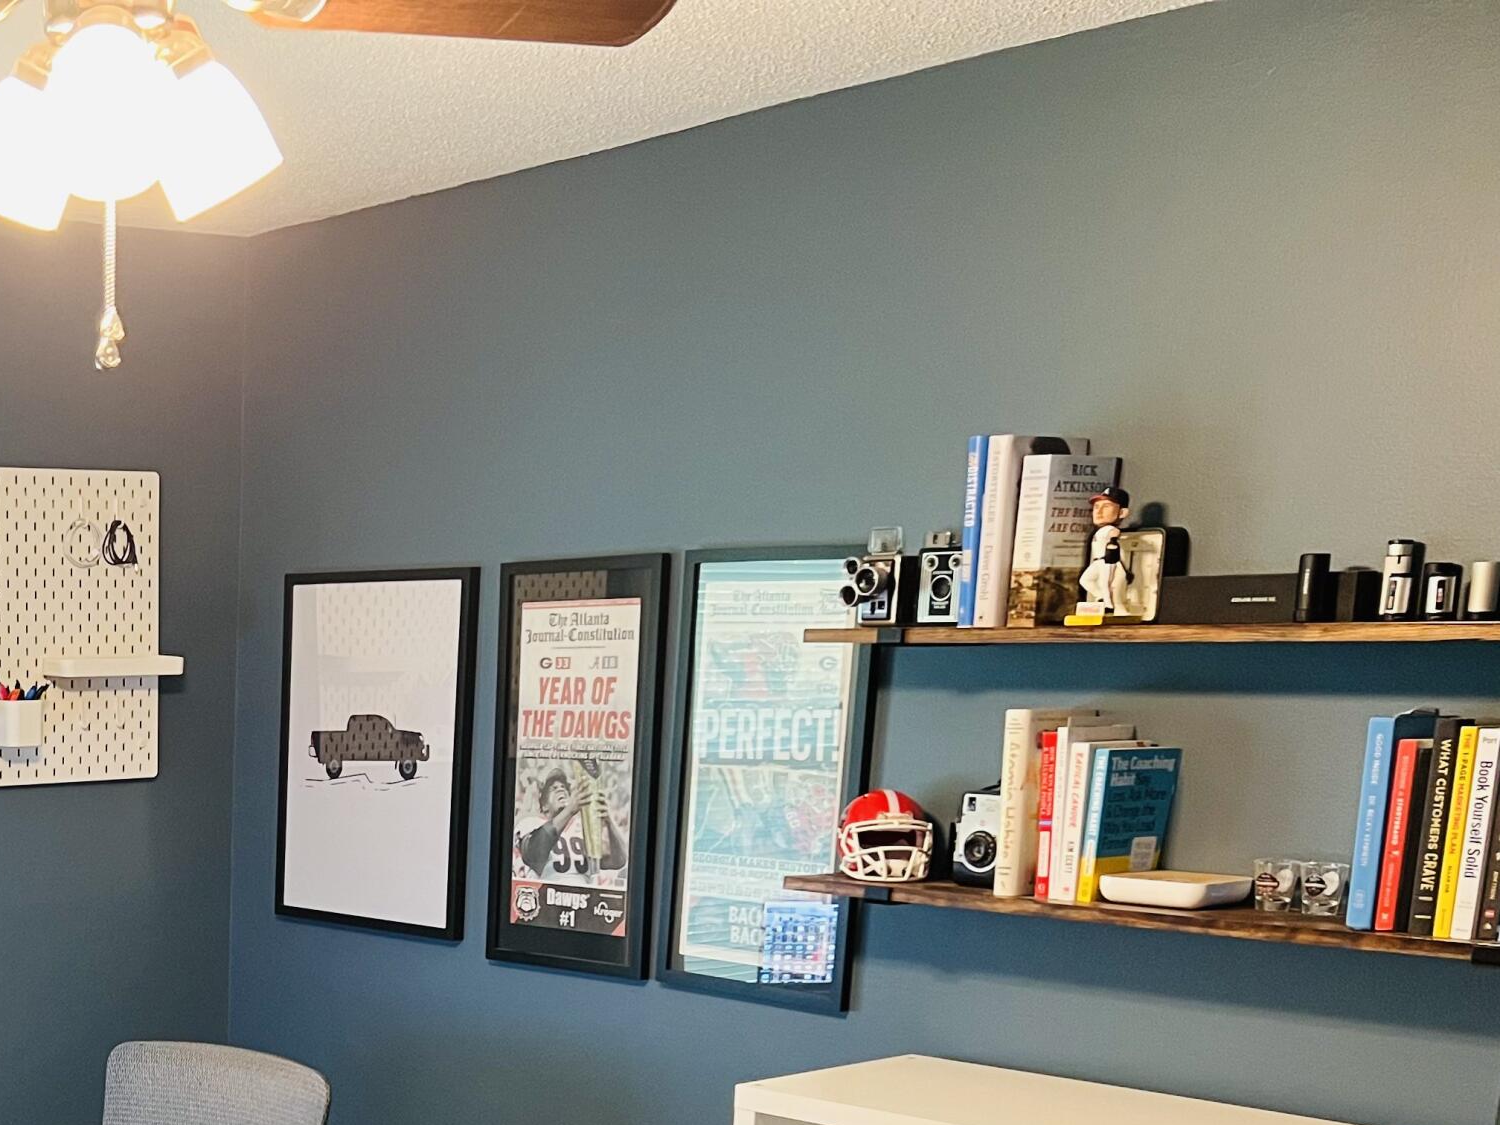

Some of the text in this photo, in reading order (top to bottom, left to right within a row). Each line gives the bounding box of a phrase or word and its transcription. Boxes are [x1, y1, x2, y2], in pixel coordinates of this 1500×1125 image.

[1071, 464, 1098, 476] RICK
[1051, 507, 1070, 517] THE
[1048, 523, 1067, 533] ARE
[549, 612, 610, 629] The Atlanta
[525, 627, 635, 644] Journal-Constitution
[540, 657, 553, 669] G
[818, 656, 838, 670] G
[539, 676, 617, 705] YEAR OF
[522, 709, 632, 739] THE DAWGS
[700, 708, 842, 761] PERFECT!
[1463, 733, 1473, 750] THE
[1373, 733, 1384, 758] GOOD
[1094, 756, 1106, 770] THE
[1112, 755, 1176, 772] The Coaching
[1437, 738, 1453, 776] WHAT
[1110, 772, 1136, 787] Habit
[1427, 777, 1447, 850] CUSTOMERS
[1451, 783, 1465, 830] MARKETING
[1464, 761, 1494, 878] Book Yourself Solid
[1449, 832, 1458, 854] PLAN
[553, 836, 589, 874] 99
[1420, 853, 1439, 891] CRAVE
[559, 910, 576, 927] #1
[728, 905, 762, 926] BAC
[730, 925, 762, 945] BAC
